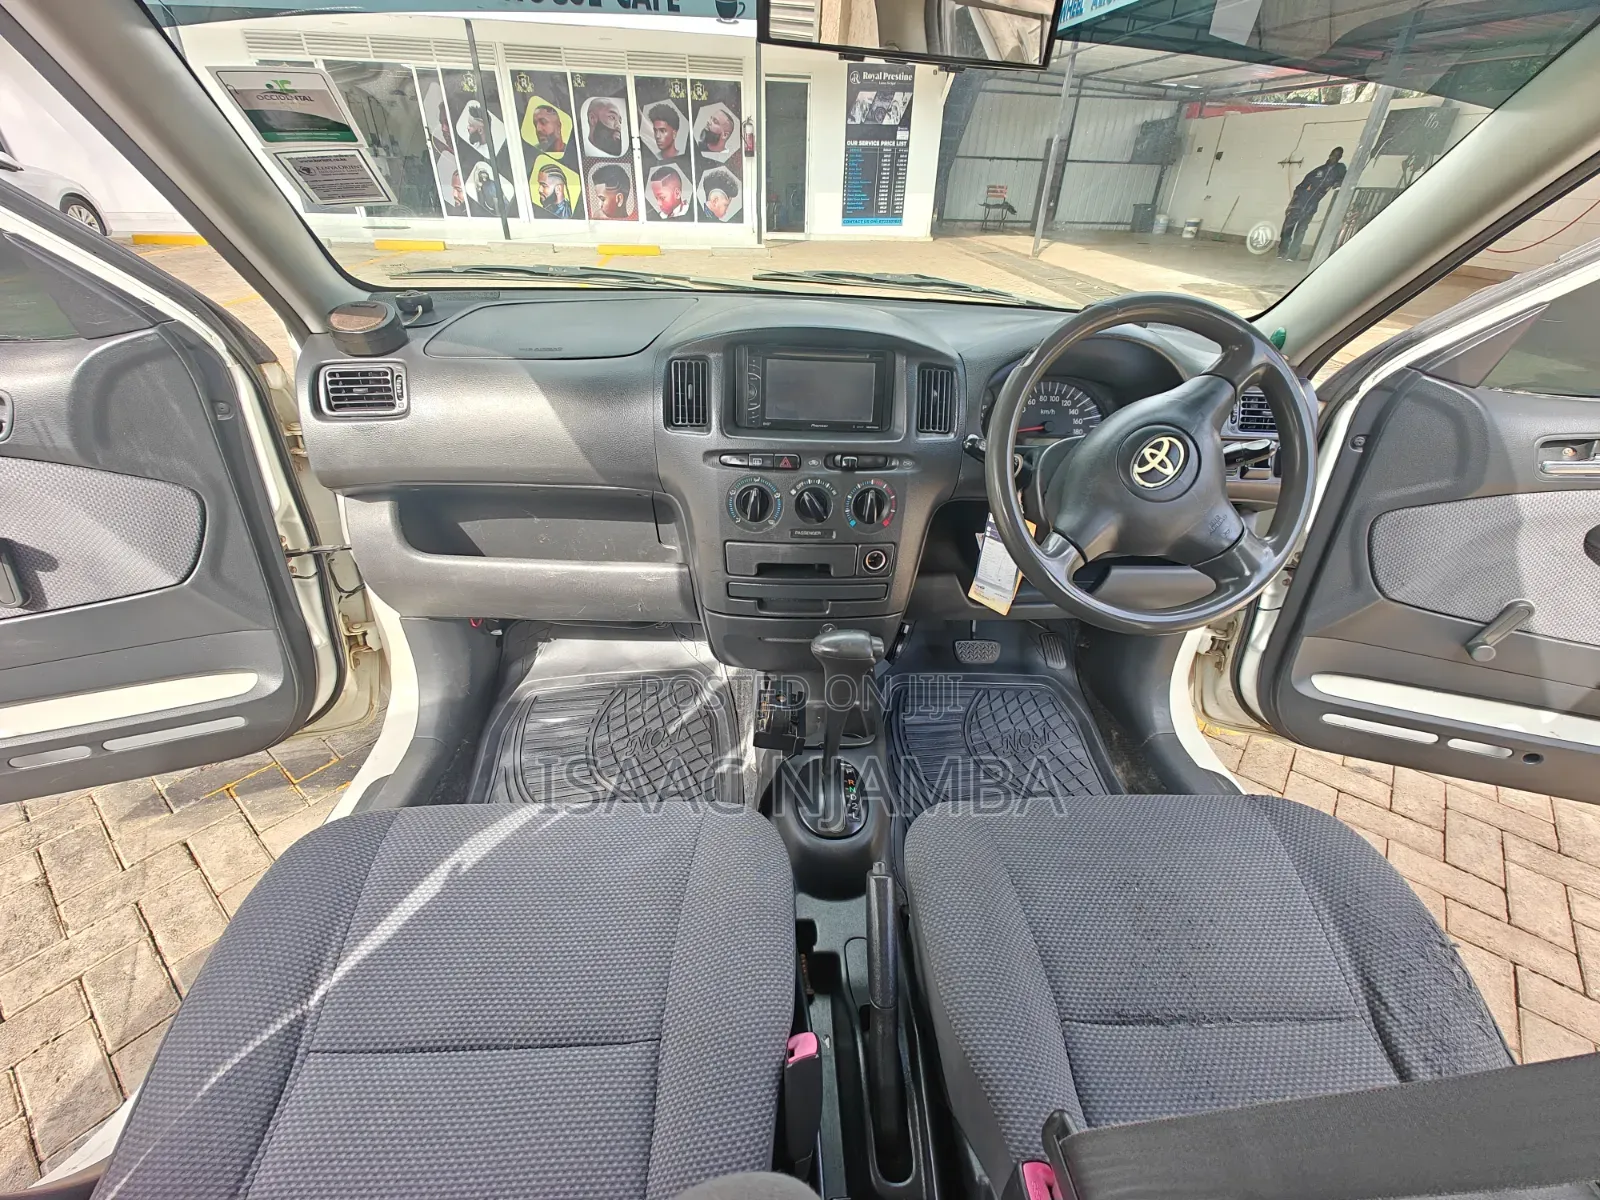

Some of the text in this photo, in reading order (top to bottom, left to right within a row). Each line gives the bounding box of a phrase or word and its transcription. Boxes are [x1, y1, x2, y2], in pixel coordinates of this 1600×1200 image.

[862, 71, 913, 81] Royal Prestine
[256, 94, 315, 102] OCCIDENTAL
